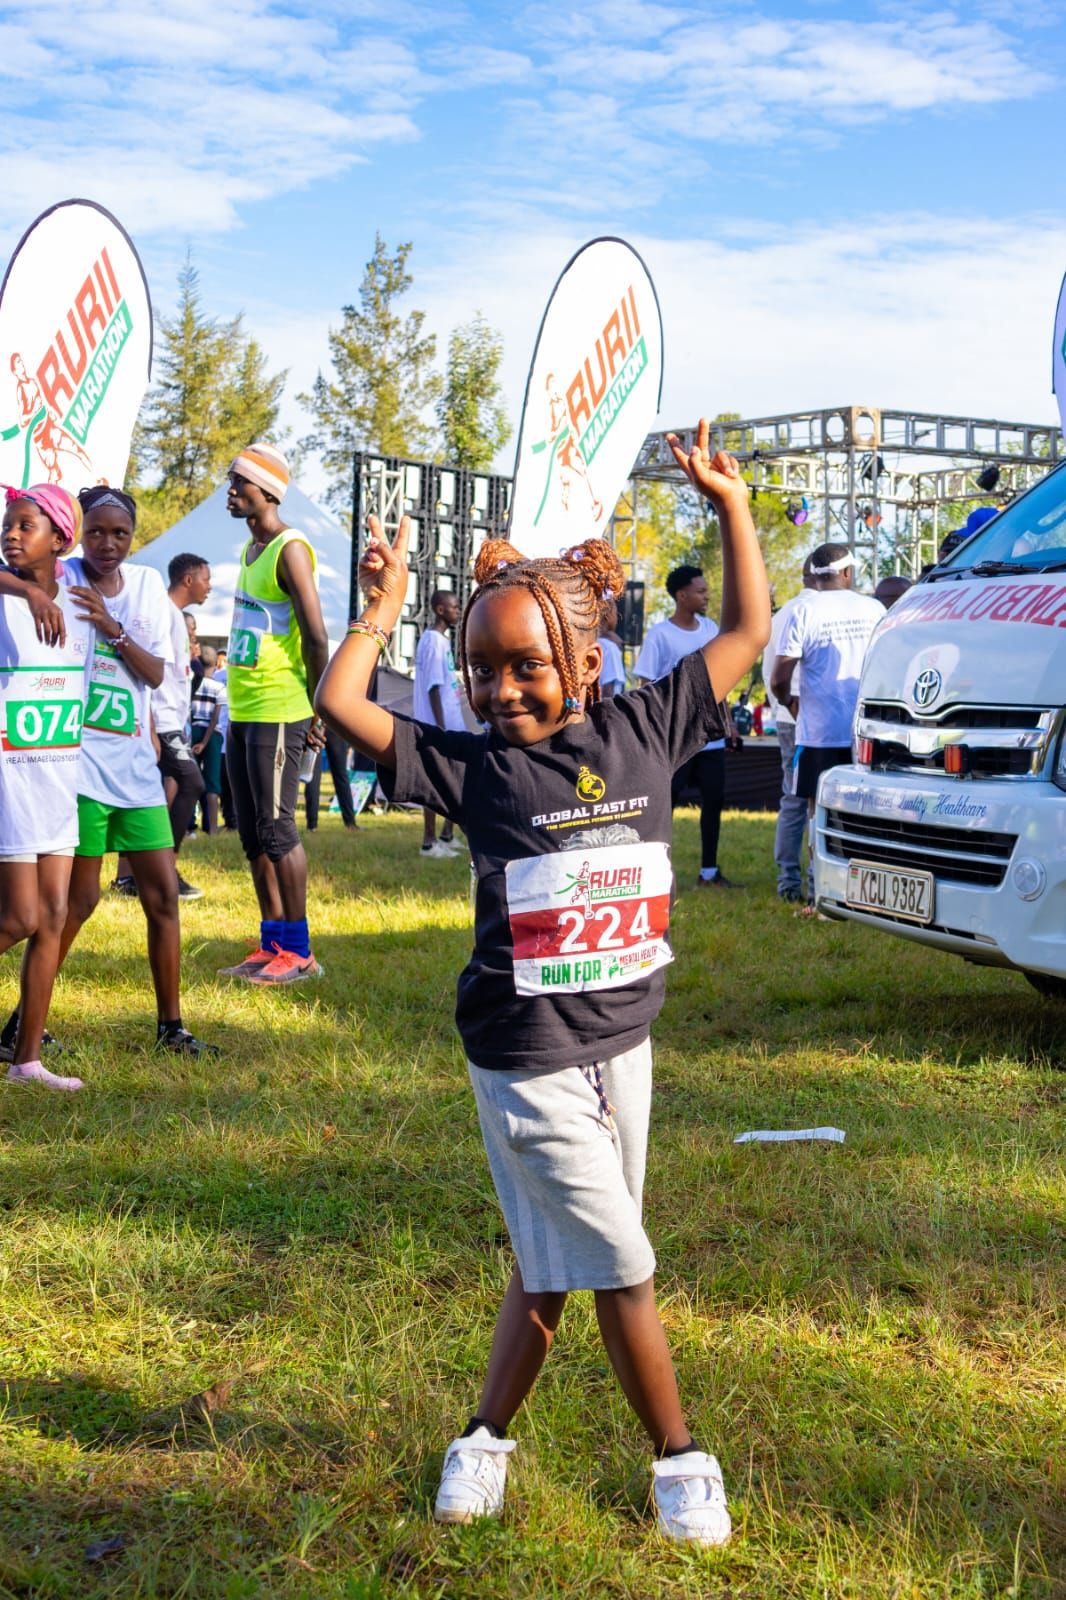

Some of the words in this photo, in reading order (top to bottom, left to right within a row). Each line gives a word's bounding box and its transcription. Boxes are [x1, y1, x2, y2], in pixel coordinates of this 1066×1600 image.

[37, 246, 122, 418] RURII
[66, 307, 131, 440] MARATHON
[565, 284, 641, 437] RURII
[580, 344, 645, 457] MARATHON
[16, 703, 82, 743] 074
[531, 806, 590, 827] GLOBAL
[592, 800, 626, 816] FAST
[628, 796, 649, 809] FIT
[931, 793, 988, 818] Healthcare
[591, 886, 639, 899] MARATHON
[860, 869, 887, 907] KCU
[892, 875, 925, 915] 938Z
[557, 901, 652, 954] 224
[541, 960, 571, 986] RUN
[574, 958, 601, 982] FOR
